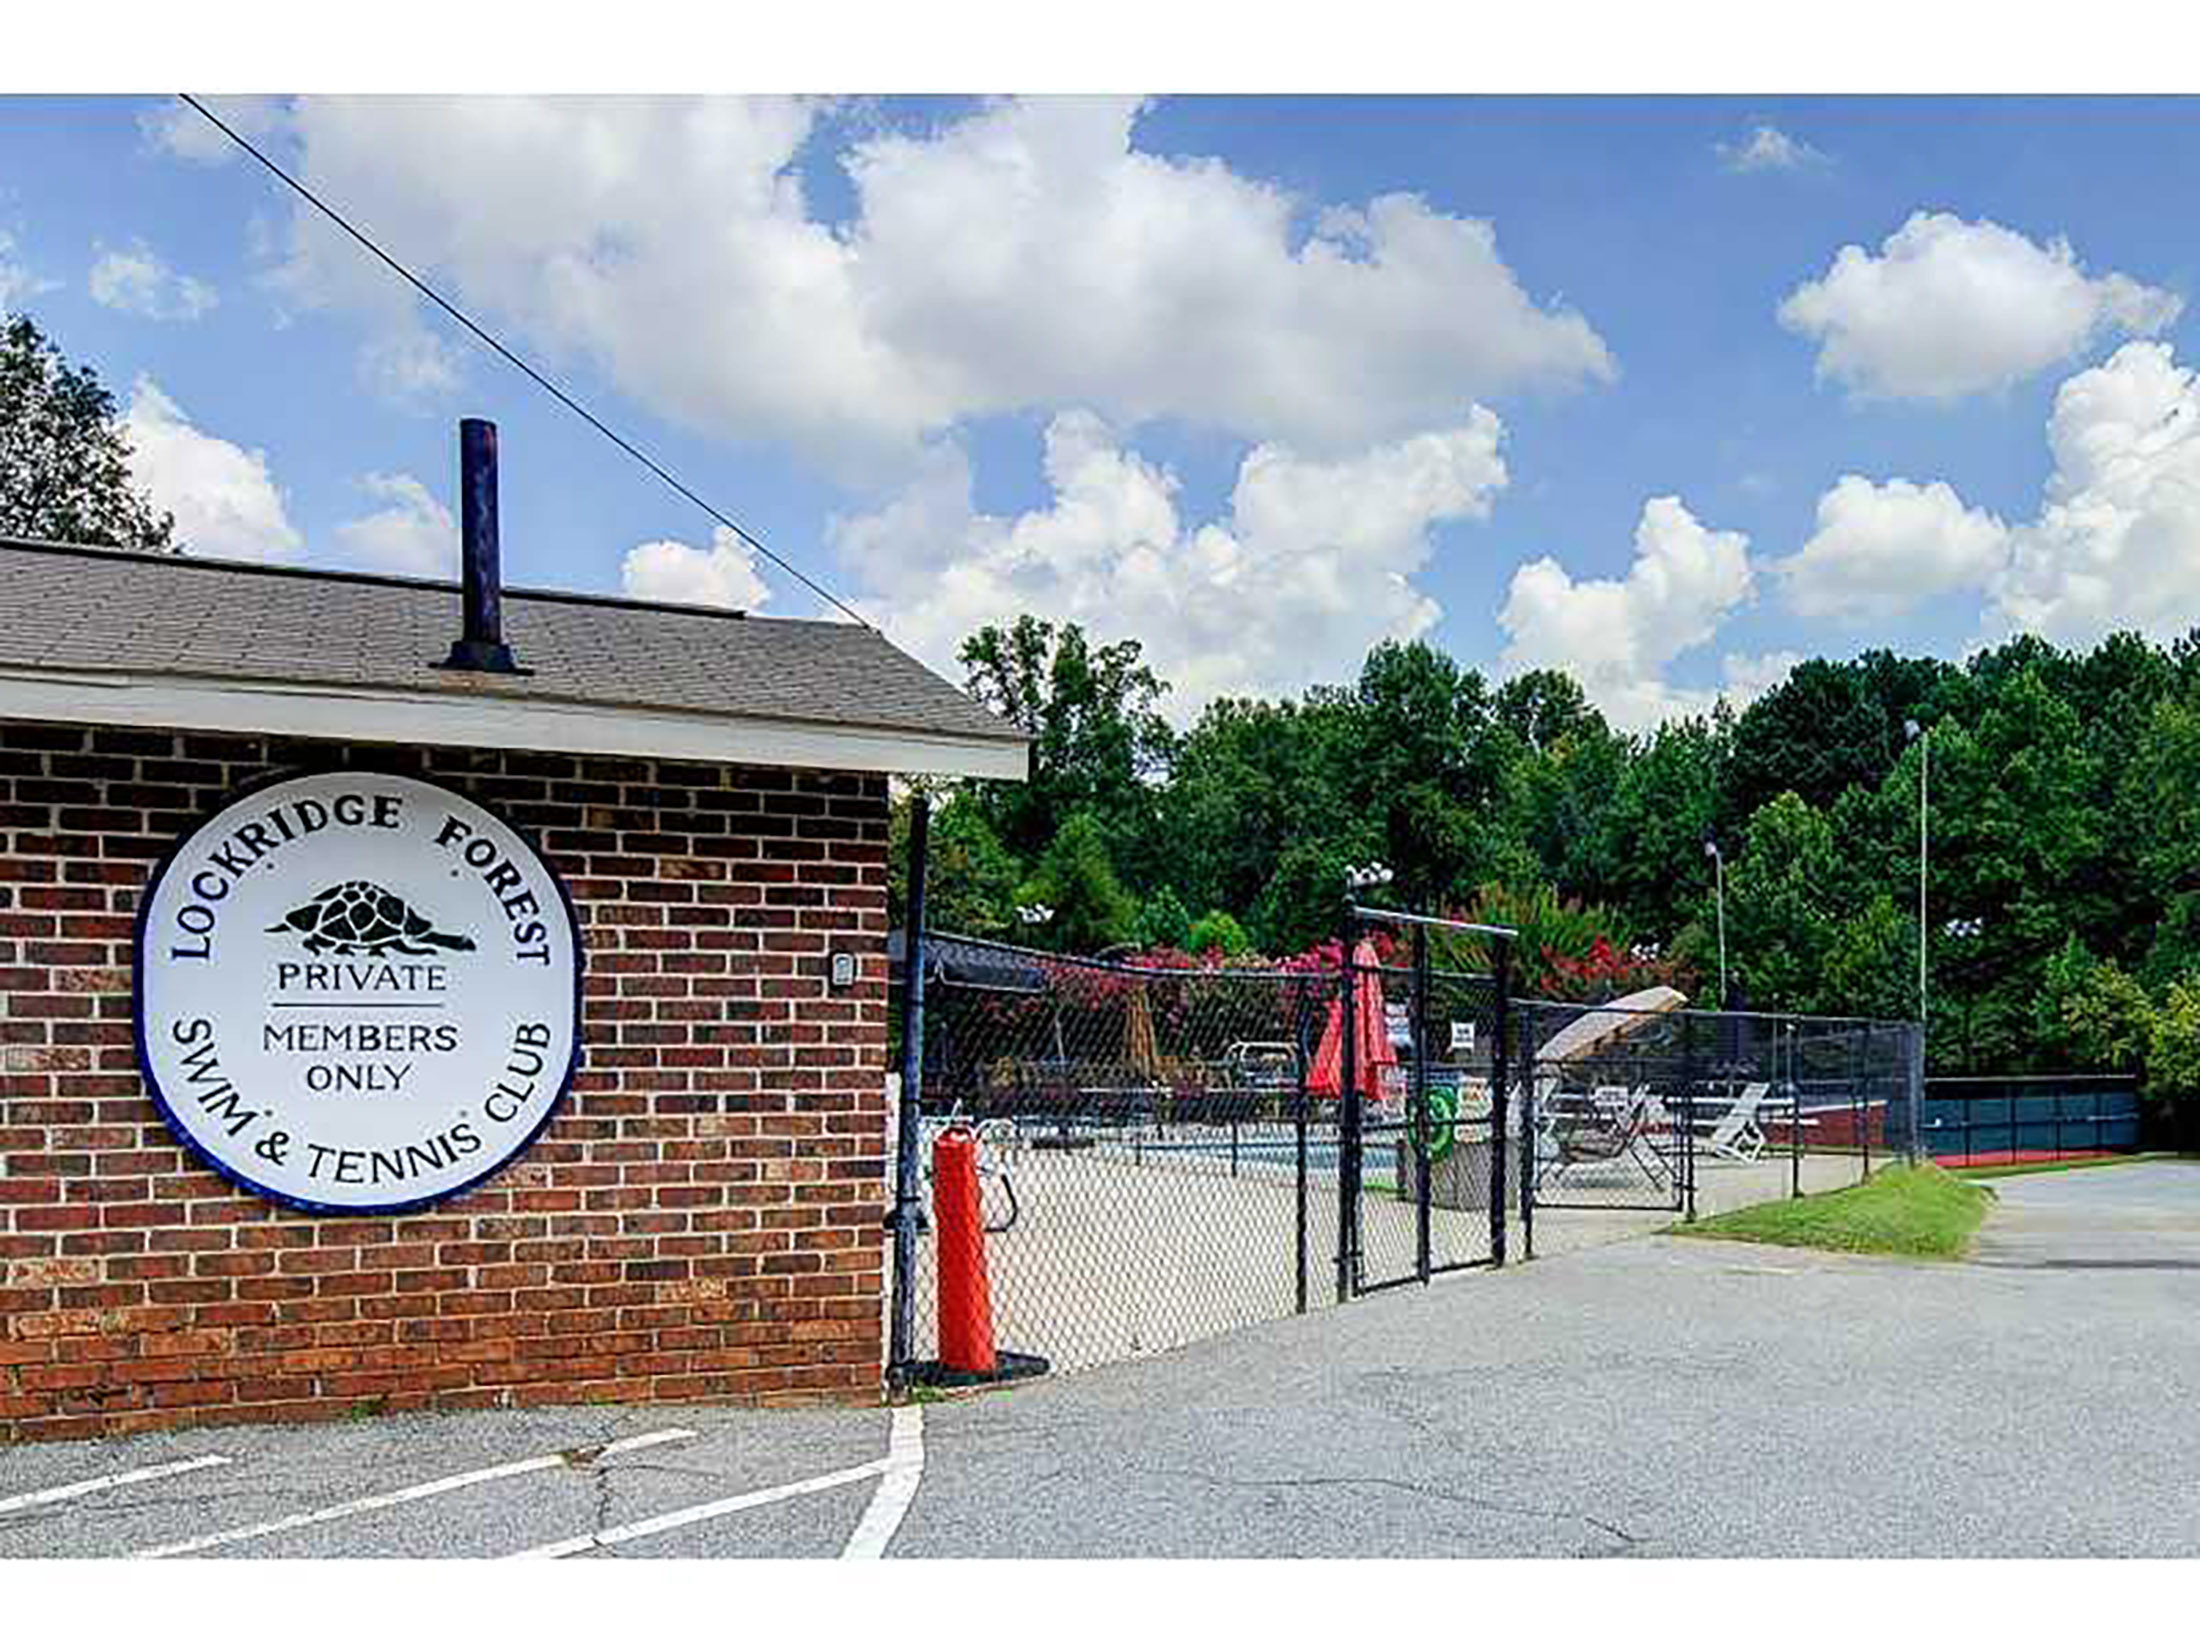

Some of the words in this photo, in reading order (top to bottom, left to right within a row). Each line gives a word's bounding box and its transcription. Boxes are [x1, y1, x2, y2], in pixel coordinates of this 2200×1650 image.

[171, 795, 402, 962] LOCKRIDGE
[433, 816, 551, 966] FOREST
[277, 963, 447, 991] PRIVATE
[263, 1025, 458, 1052] MEMBERS
[306, 1064, 412, 1091] ONLY
[173, 1018, 258, 1138] SWIM
[255, 1131, 289, 1166] &
[306, 1123, 482, 1184] TENNIS
[485, 1021, 551, 1123] CLUB
